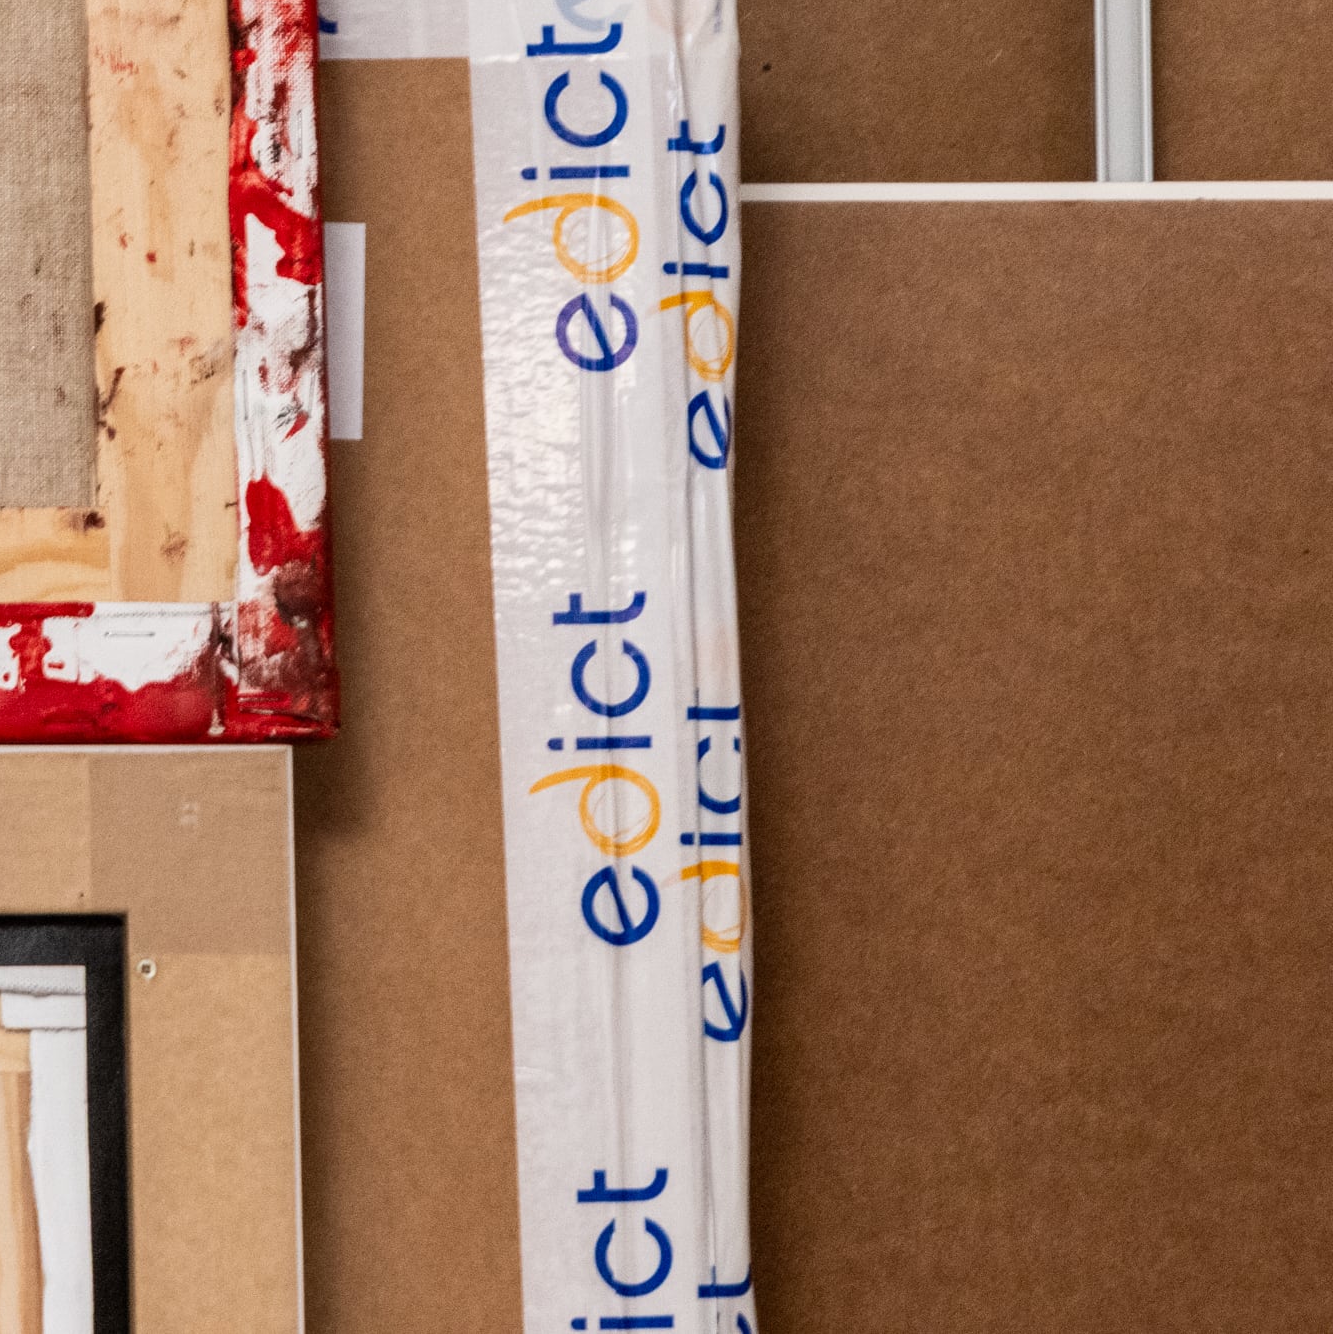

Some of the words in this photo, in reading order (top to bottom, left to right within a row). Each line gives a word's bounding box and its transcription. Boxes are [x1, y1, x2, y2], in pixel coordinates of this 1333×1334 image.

[503, 23, 640, 372] edict
[660, 119, 735, 470] edict
[529, 590, 661, 947] edict
[570, 1167, 675, 1331] ict
